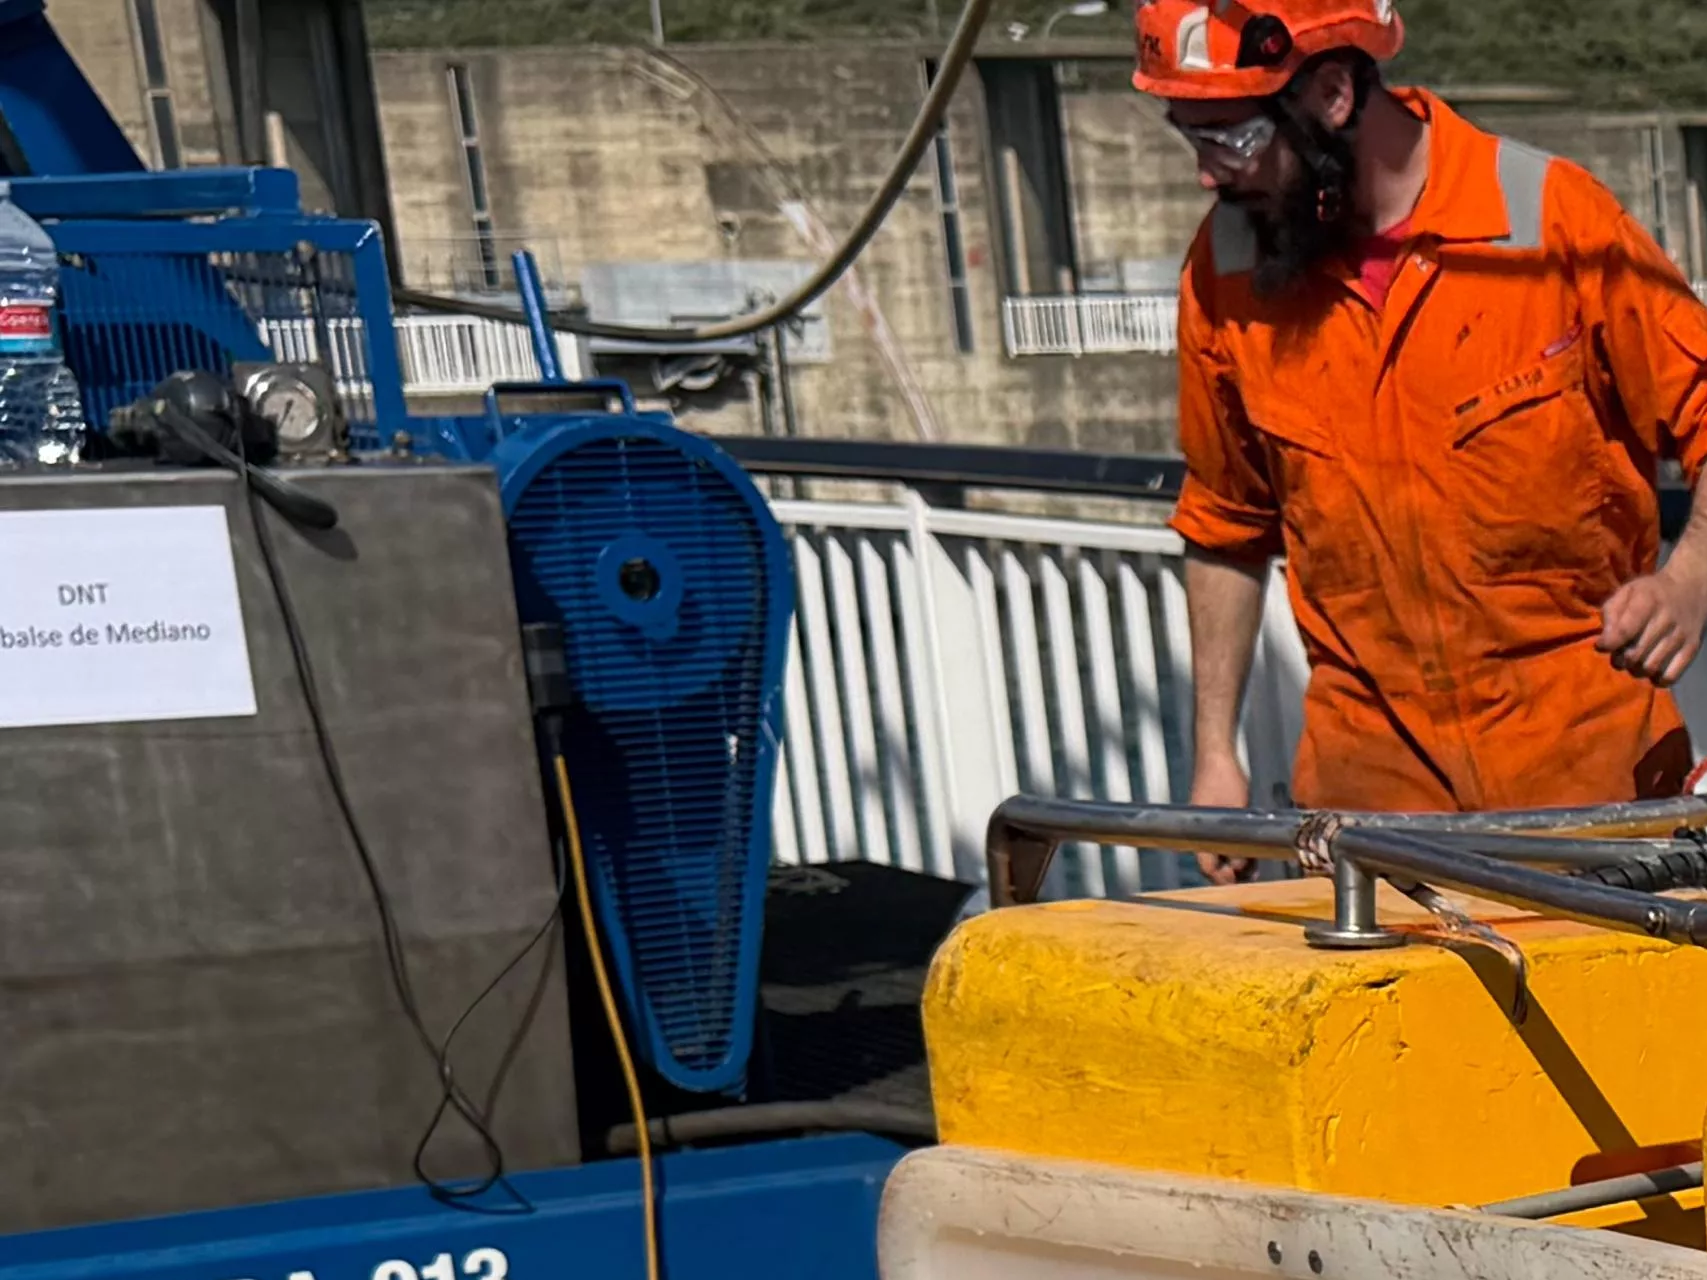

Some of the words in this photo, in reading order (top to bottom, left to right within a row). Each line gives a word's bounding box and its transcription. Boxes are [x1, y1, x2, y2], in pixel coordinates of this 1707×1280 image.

[57, 583, 108, 606] DNT
[69, 623, 99, 646] de
[106, 621, 211, 645] Mediano
